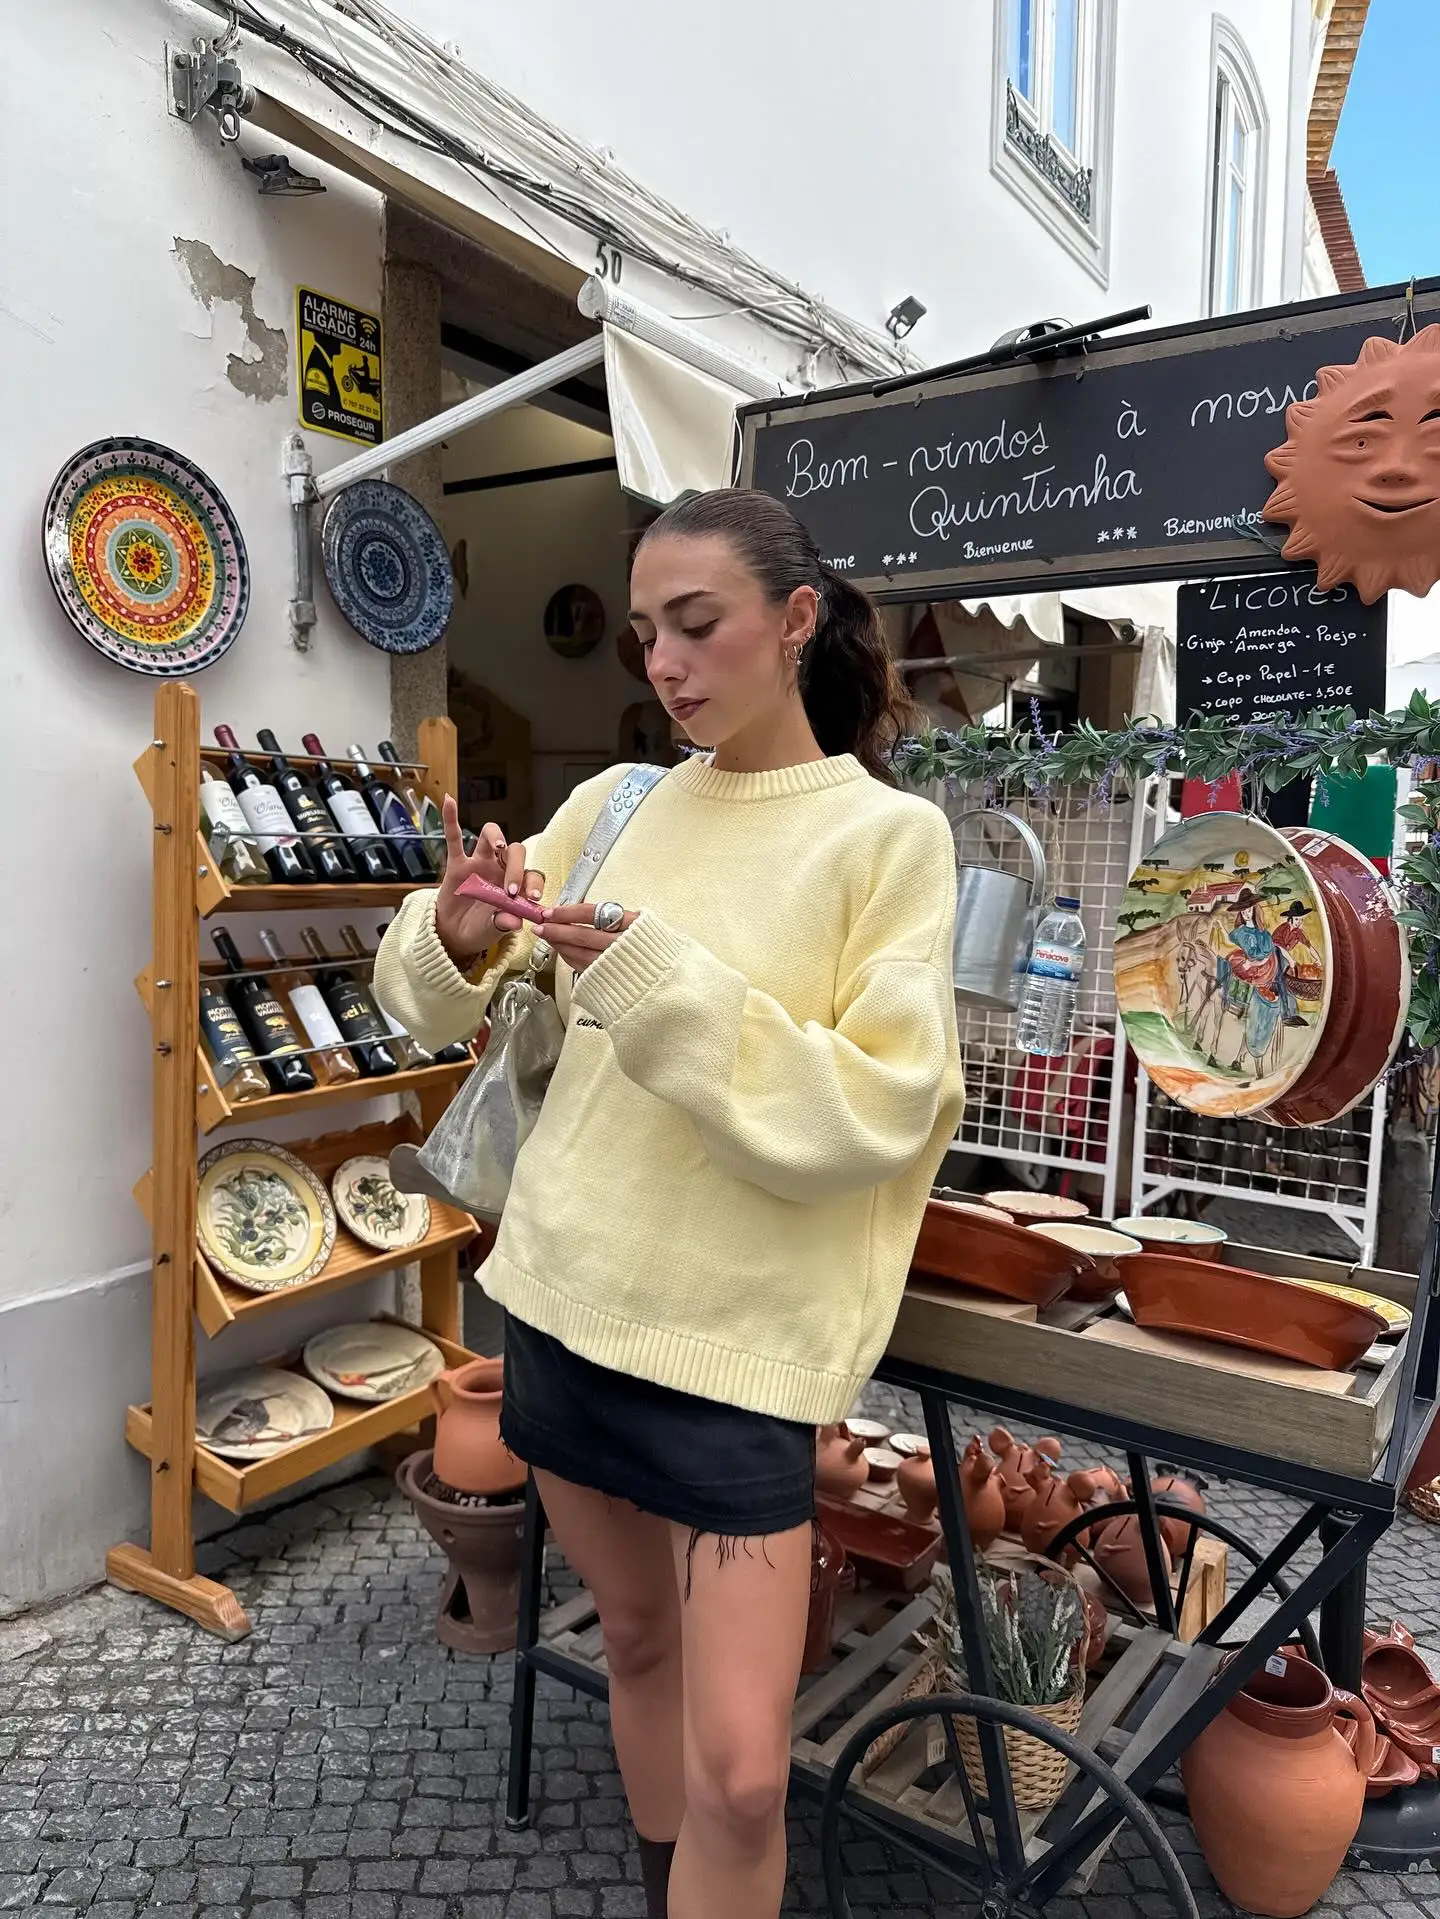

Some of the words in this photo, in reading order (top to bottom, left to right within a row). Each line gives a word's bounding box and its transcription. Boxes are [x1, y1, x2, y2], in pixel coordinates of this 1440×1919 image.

[595, 239, 622, 285] 50
[303, 308, 357, 339] LIGADO
[304, 295, 356, 326] ALARME
[359, 337, 376, 353] 24h
[327, 409, 375, 433] PROSEGUR
[1116, 400, 1147, 439] à
[909, 453, 1143, 541] Quintinha
[963, 537, 1034, 560] Bienvenue
[1163, 507, 1265, 537] Bienvenidos
[1186, 635, 1226, 654] Ginja
[1235, 625, 1301, 640] Amendoa
[1316, 625, 1357, 646] Poejo
[1234, 640, 1296, 654] Amarga
[1259, 664, 1297, 684] Papel
